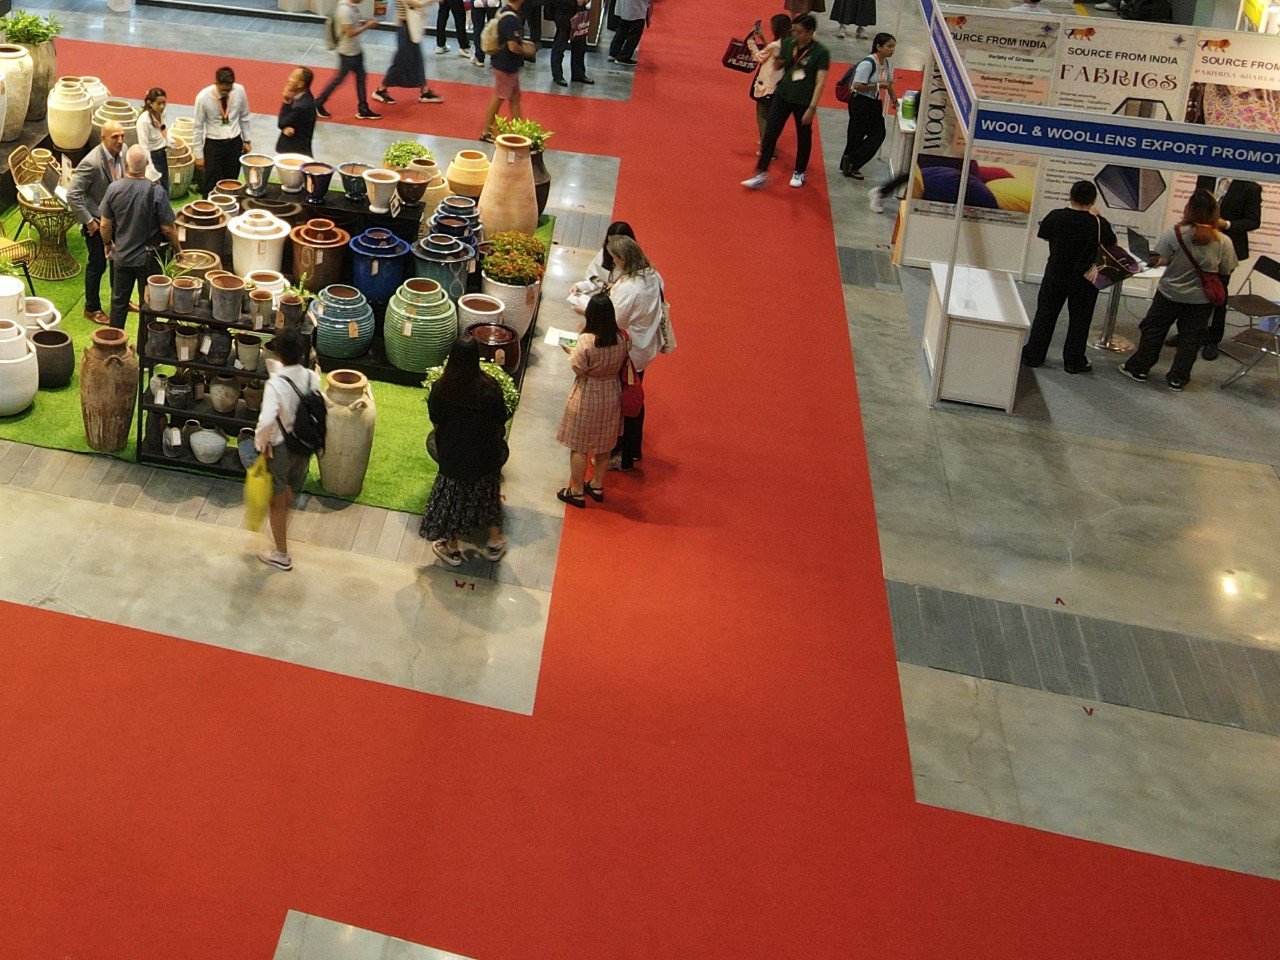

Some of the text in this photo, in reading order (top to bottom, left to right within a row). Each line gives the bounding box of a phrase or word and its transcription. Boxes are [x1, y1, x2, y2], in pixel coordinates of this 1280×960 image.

[986, 36, 1047, 49] FROM INDIA
[1068, 47, 1178, 65] SOURCE FROM INDIA
[1202, 56, 1247, 68] SOURCE
[1004, 77, 1033, 85] Techniques
[981, 119, 1027, 135] WOOL
[1032, 126, 1042, 137] &
[1048, 127, 1137, 148] WOOLLENS
[1141, 139, 1207, 156] EXPORT
